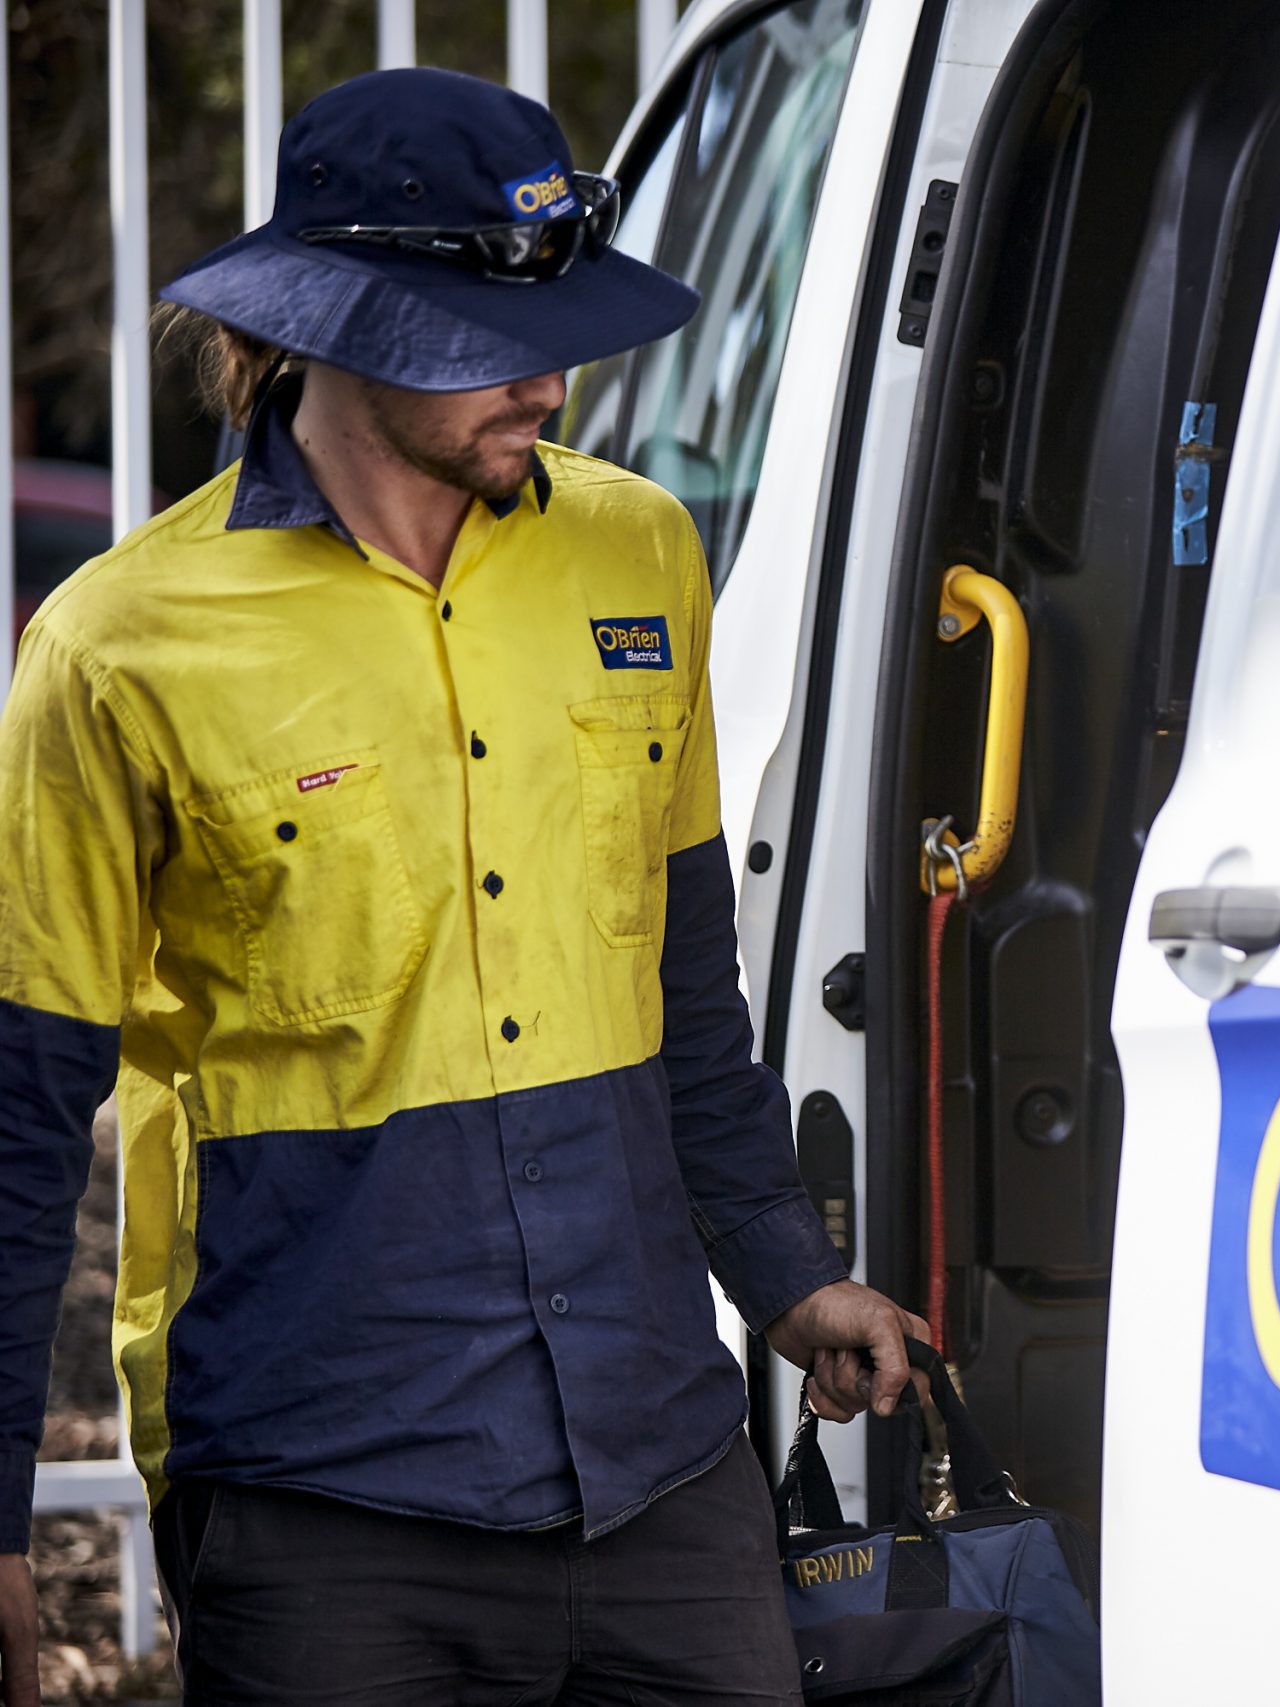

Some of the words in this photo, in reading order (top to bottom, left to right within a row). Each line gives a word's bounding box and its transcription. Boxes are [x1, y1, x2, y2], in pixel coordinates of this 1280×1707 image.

[597, 625, 660, 651] O'Brien
[302, 774, 327, 788] Hard
[794, 1546, 873, 1588] IRWIN
